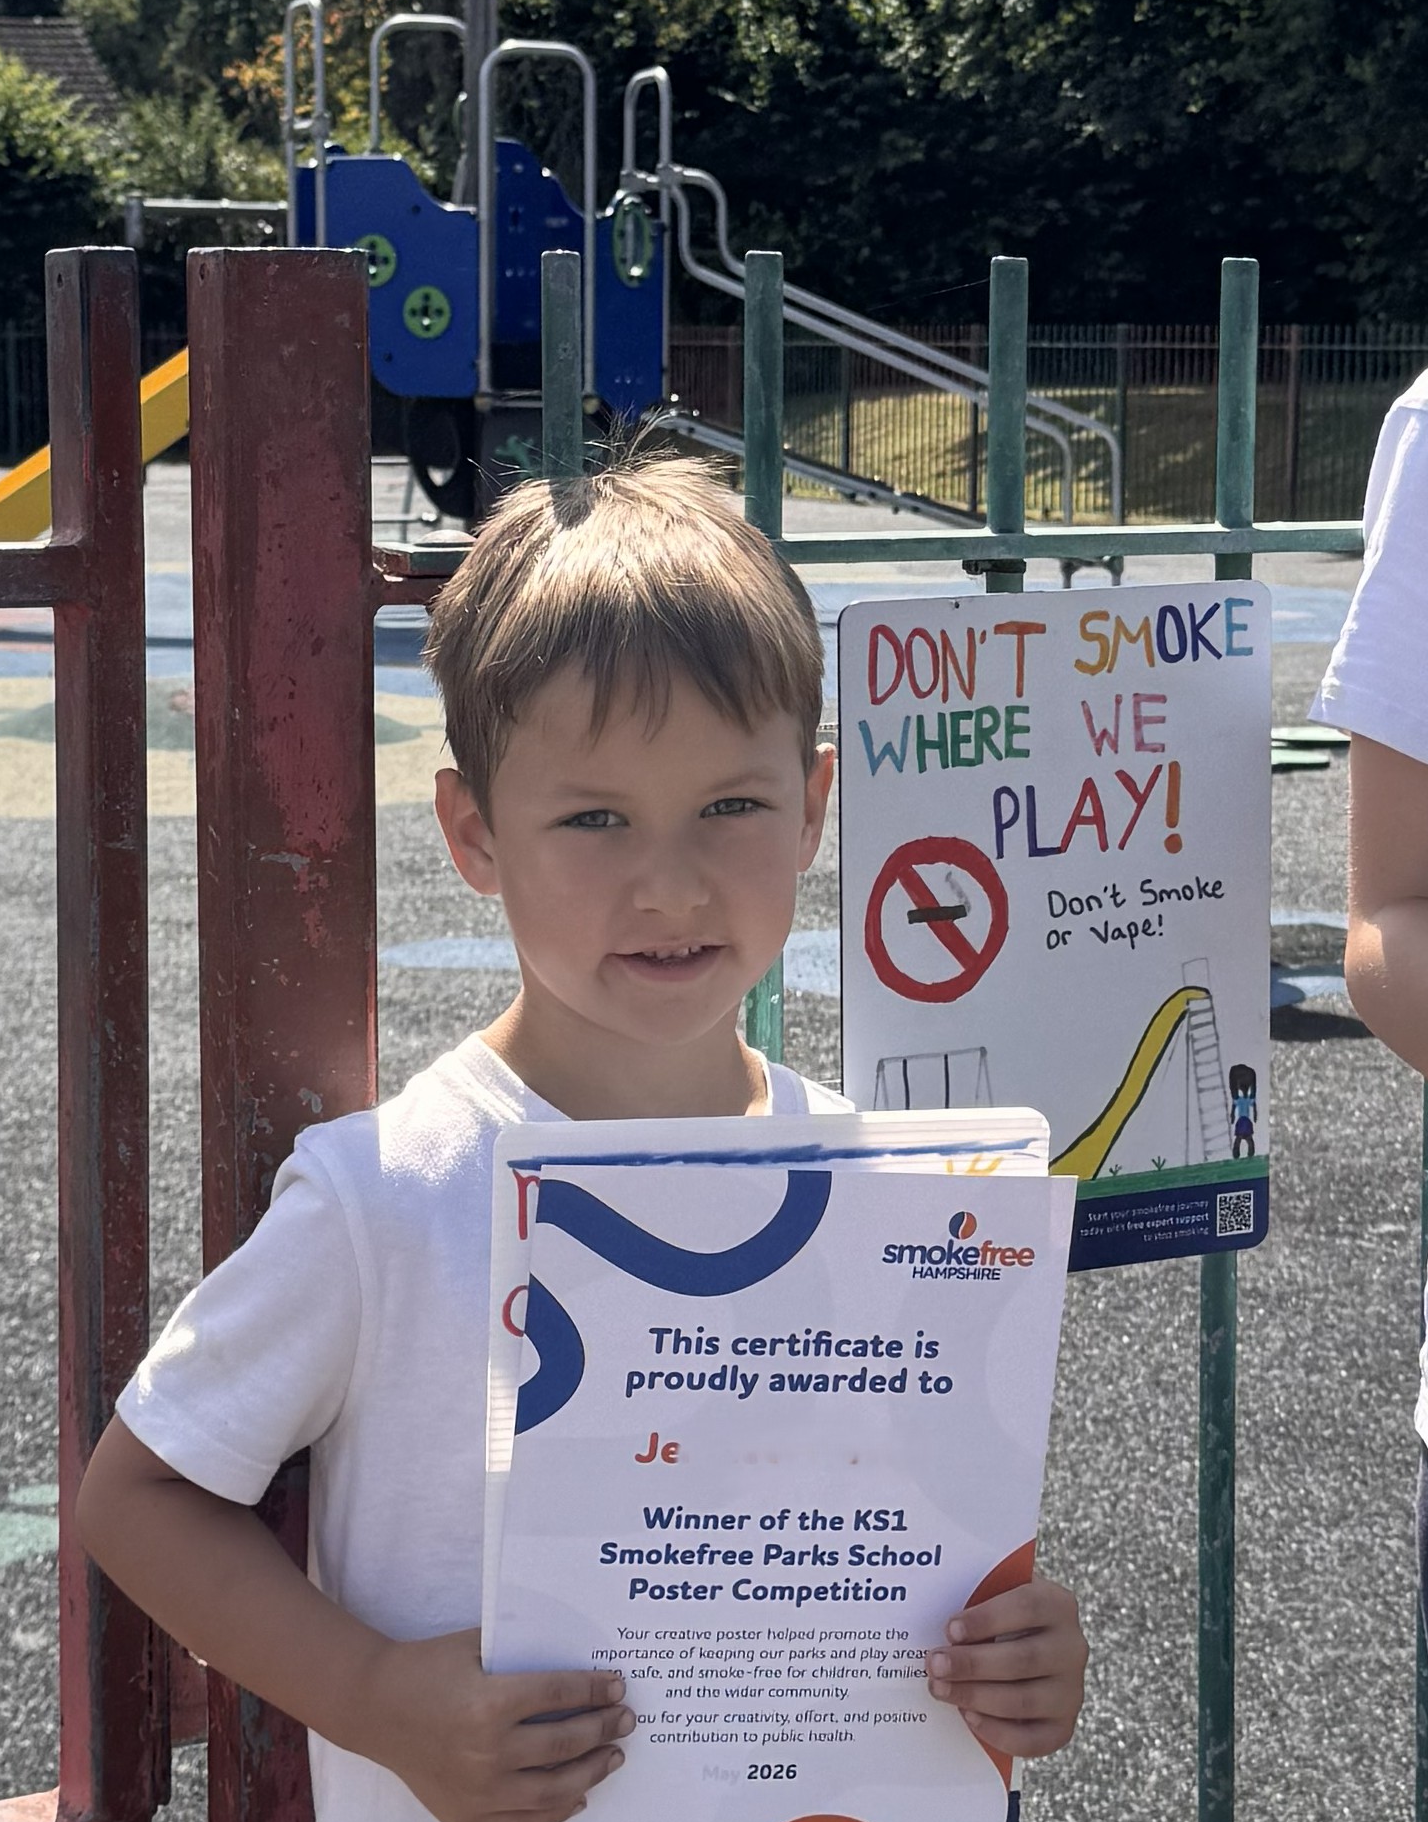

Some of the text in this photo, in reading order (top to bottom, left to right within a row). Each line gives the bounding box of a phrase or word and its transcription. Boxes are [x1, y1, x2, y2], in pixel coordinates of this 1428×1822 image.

[868, 597, 1253, 705] DON'T SMOKE
[858, 693, 1167, 776] WHERE WE
[992, 761, 1181, 860] PLAY!
[1047, 876, 1225, 918] Don't Smoke
[1046, 914, 1165, 950] or Vape!
[882, 1236, 1034, 1268] smokefree
[912, 1265, 1001, 1281] HAMPSHIRE
[648, 1327, 939, 1359] This certificate is
[625, 1366, 953, 1399] proudly awarded to
[635, 1432, 680, 1463] Je
[643, 1506, 907, 1532] Winner of the KS1
[600, 1542, 941, 1568] Smokefree Parks School
[628, 1577, 907, 1609] Poster Competition
[618, 1628, 909, 1643] Your creative poster helped promote the
[592, 1647, 675, 1661] importance
[679, 1647, 695, 1658] of
[699, 1647, 754, 1661] keeping
[759, 1649, 784, 1658] our
[789, 1648, 826, 1661] parks
[830, 1647, 856, 1659] and
[860, 1647, 888, 1662] play
[631, 1665, 663, 1679] safe,
[668, 1666, 694, 1678] and
[698, 1666, 782, 1678] smoke-free
[787, 1666, 808, 1679] for
[812, 1667, 871, 1679] children,
[666, 1686, 691, 1698] and
[696, 1686, 720, 1698] the
[725, 1686, 764, 1698] wider
[635, 1711, 927, 1726] ou for your creativity, effort, and positive
[650, 1731, 738, 1743] contribution
[743, 1732, 757, 1743] to
[762, 1730, 804, 1745] public
[747, 1764, 797, 1779] 2026
